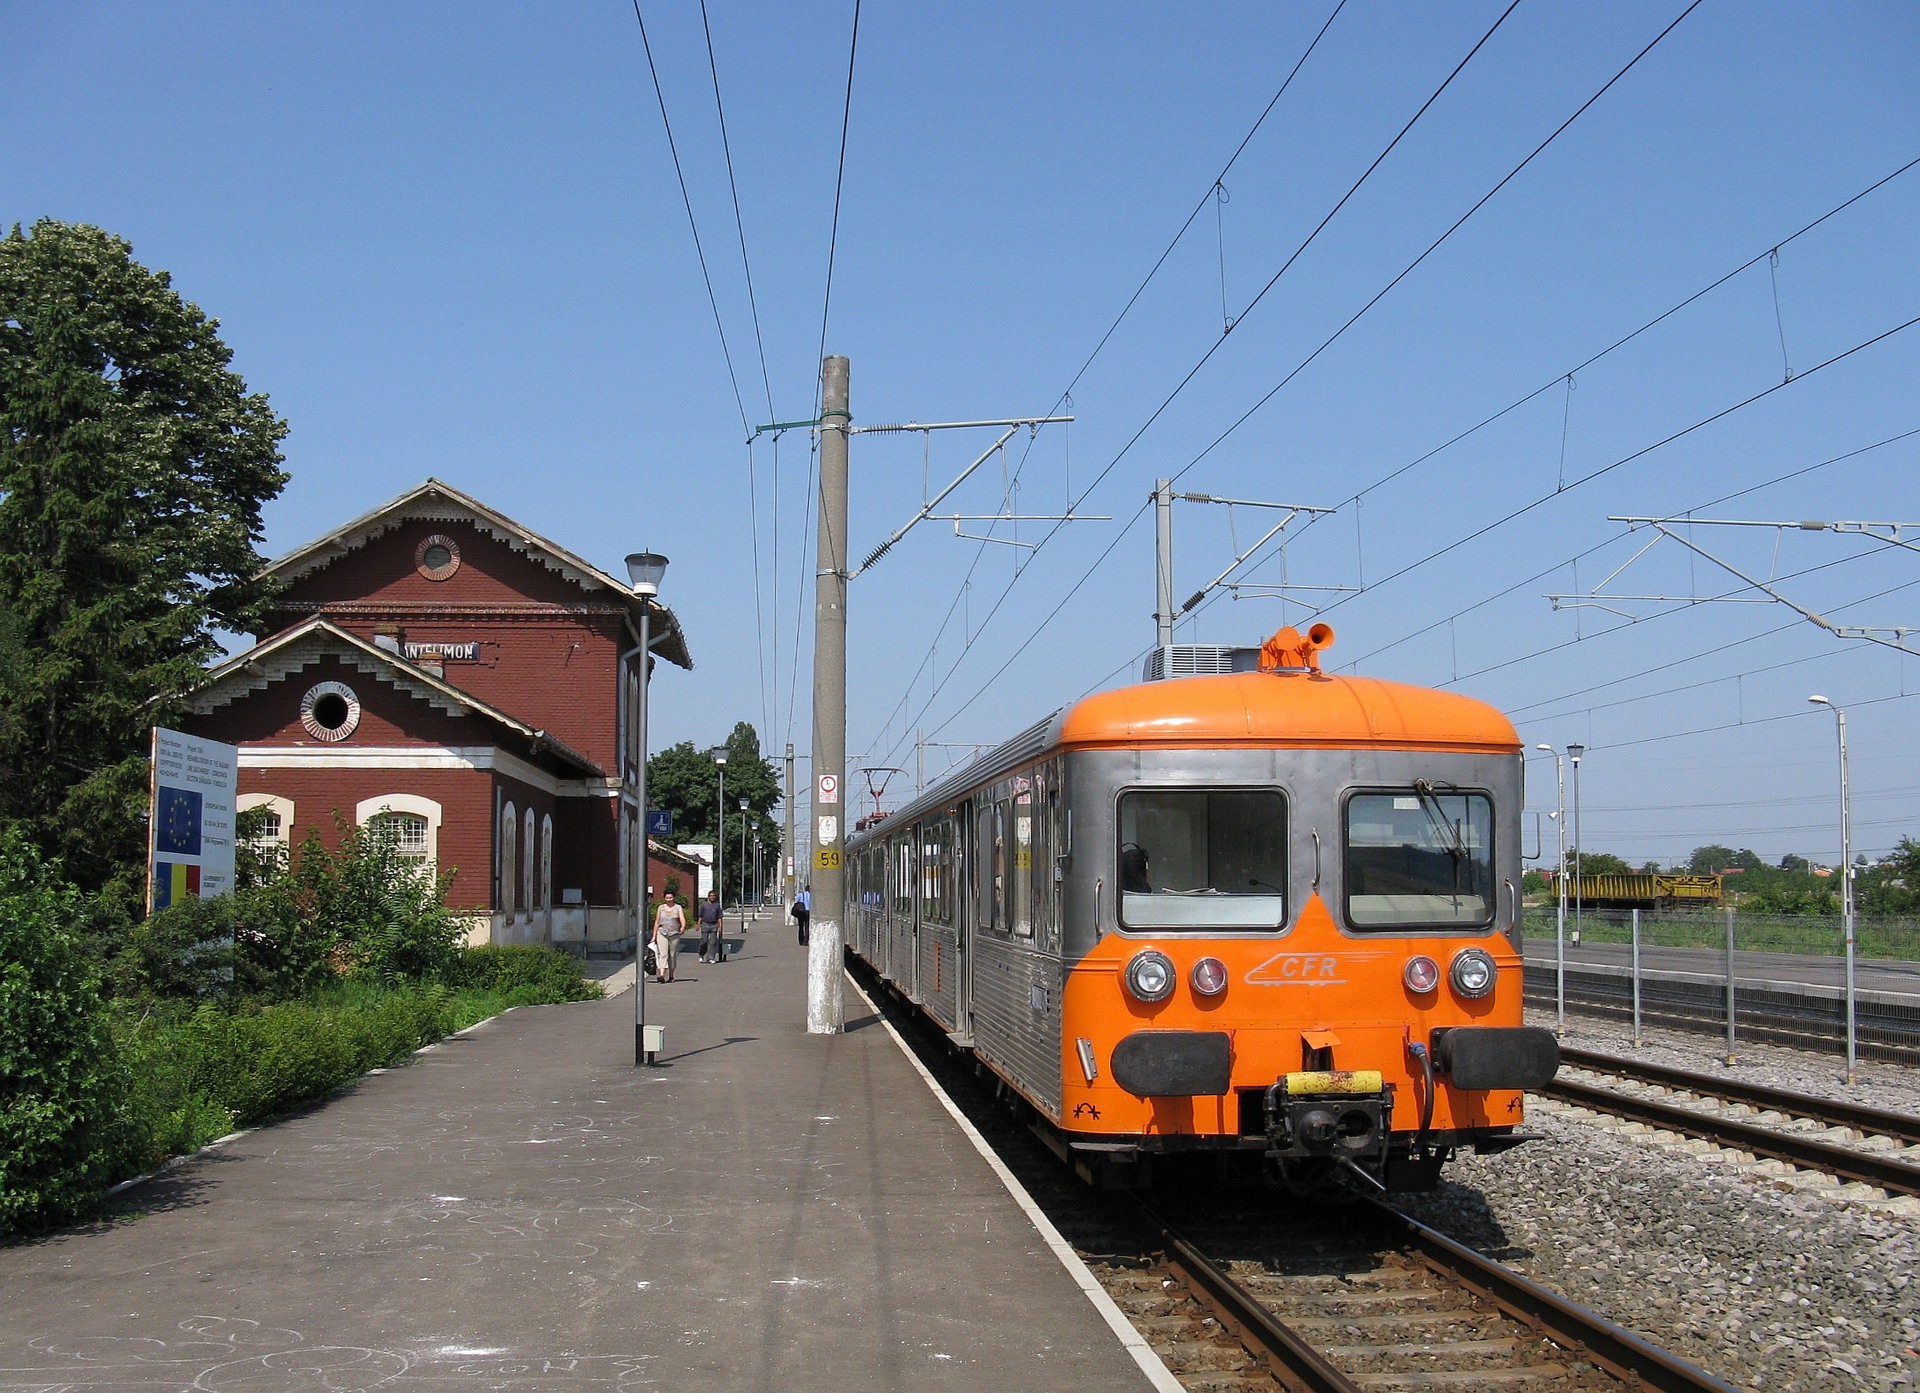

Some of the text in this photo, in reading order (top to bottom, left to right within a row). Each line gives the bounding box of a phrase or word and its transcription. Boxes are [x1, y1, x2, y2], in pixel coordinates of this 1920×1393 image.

[404, 644, 473, 659] ANTELIMON
[821, 852, 839, 866] 59
[1282, 957, 1337, 977] CFR
